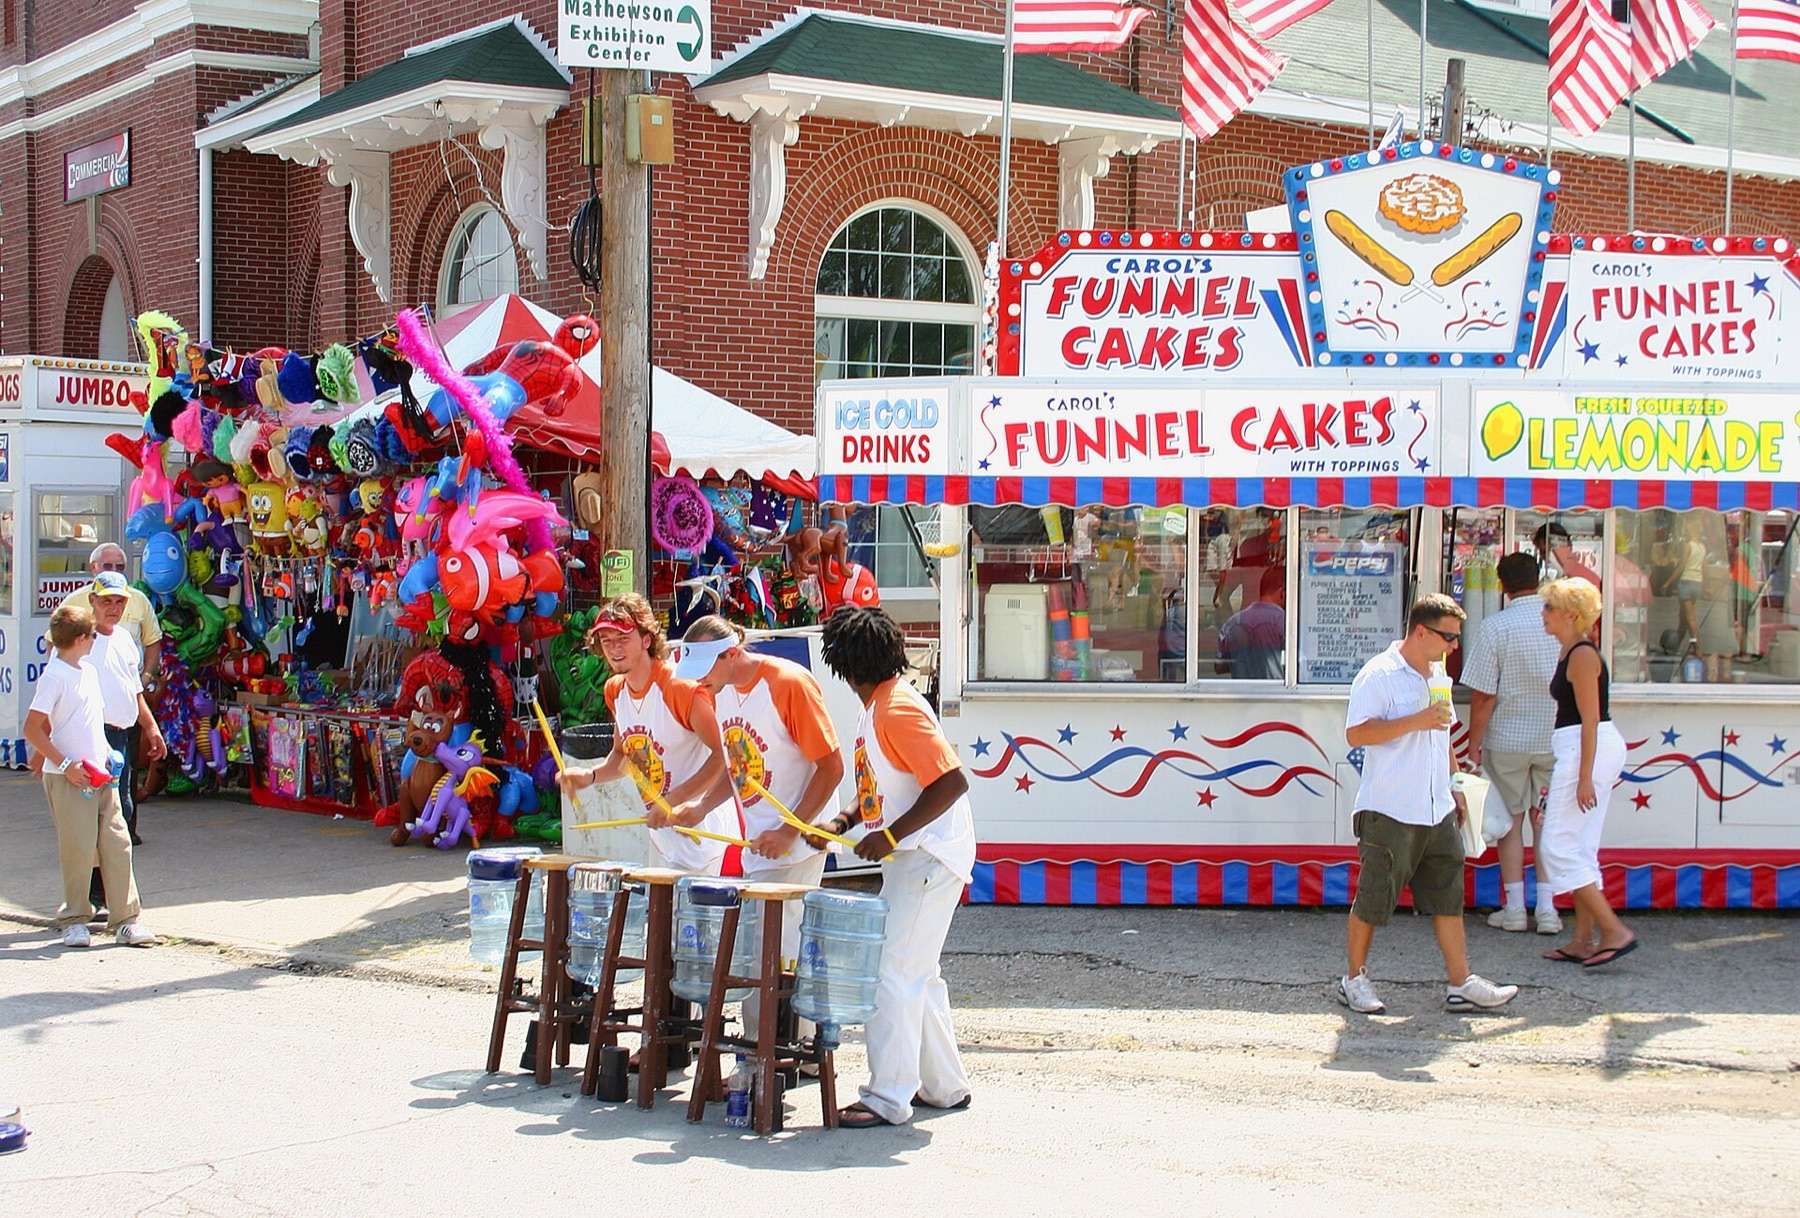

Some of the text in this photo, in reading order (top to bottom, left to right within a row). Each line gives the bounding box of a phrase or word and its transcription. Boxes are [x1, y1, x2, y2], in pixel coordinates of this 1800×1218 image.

[564, 0, 673, 22] Mathewson
[570, 24, 665, 45] Exhibition
[587, 44, 651, 62] Center
[1106, 256, 1213, 274] CAROL'S
[1592, 263, 1652, 278] CAROL'S
[1046, 275, 1260, 319] FUNNEL
[1592, 280, 1743, 322] FUNNEL
[1061, 326, 1246, 371] CAKES
[1639, 318, 1757, 360] CAKES
[1672, 365, 1762, 379] WITH TOPPINGS
[55, 376, 131, 407] JUMBO
[1046, 392, 1115, 411] CAROL'S
[835, 399, 939, 430] ICE COLD
[1575, 397, 1728, 416] FRESH SQUEEZED
[1004, 396, 1398, 468] FUNNEL CAKES
[842, 434, 931, 464] DRINKS
[1528, 416, 1784, 474] LEMONADE
[1290, 460, 1400, 473] WITH TOPPINGS
[1331, 556, 1389, 571] PEPSI
